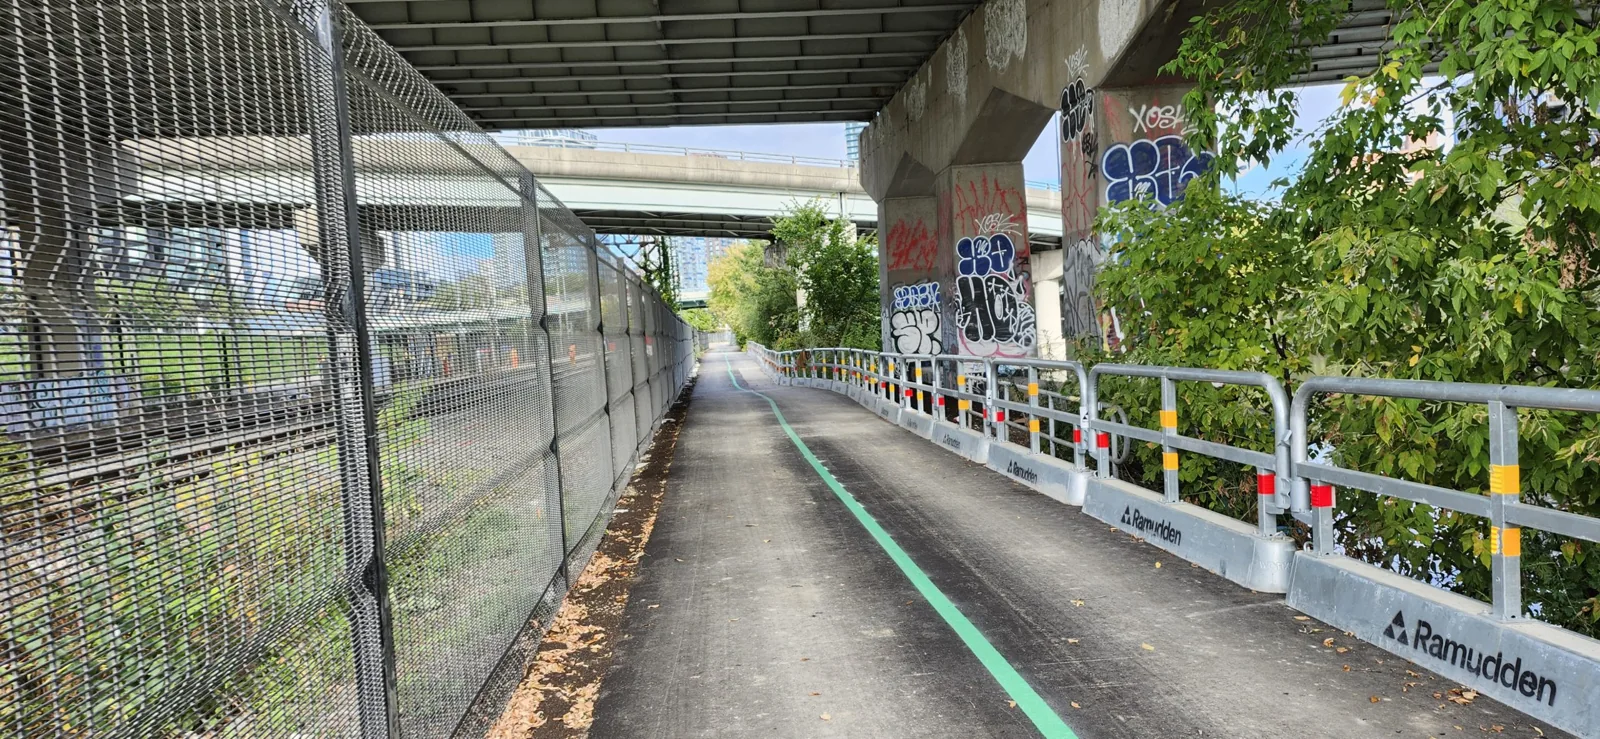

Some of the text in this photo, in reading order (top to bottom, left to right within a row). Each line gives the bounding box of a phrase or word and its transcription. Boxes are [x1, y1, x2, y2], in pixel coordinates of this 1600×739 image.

[1013, 461, 1037, 484] Ramudden
[1132, 508, 1181, 545] Ramudden
[1414, 619, 1556, 706] Ramudden
